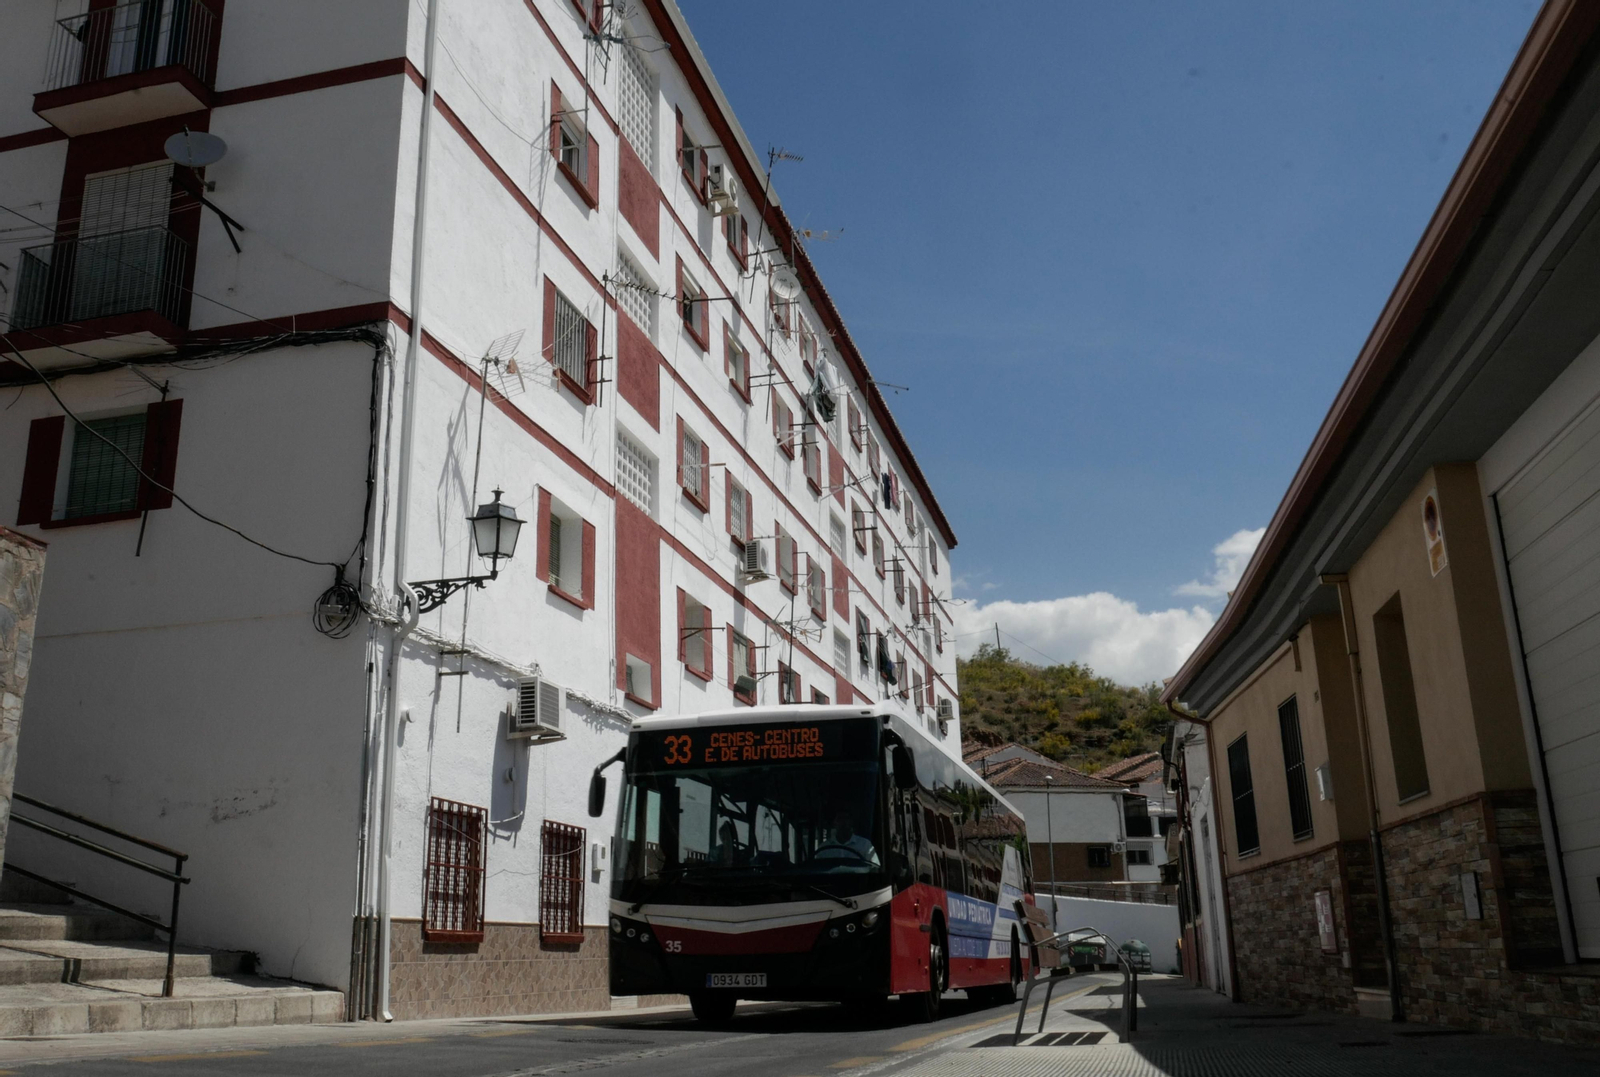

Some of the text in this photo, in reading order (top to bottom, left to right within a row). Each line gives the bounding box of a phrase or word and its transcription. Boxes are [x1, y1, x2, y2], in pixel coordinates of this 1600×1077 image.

[764, 727, 819, 745] CENTRO
[664, 734, 692, 765] 33
[705, 742, 824, 763] E. DE AUTOBUSES
[948, 897, 967, 920] UNIDAD
[665, 940, 682, 952] 35
[713, 974, 765, 986] 0934 GDT
